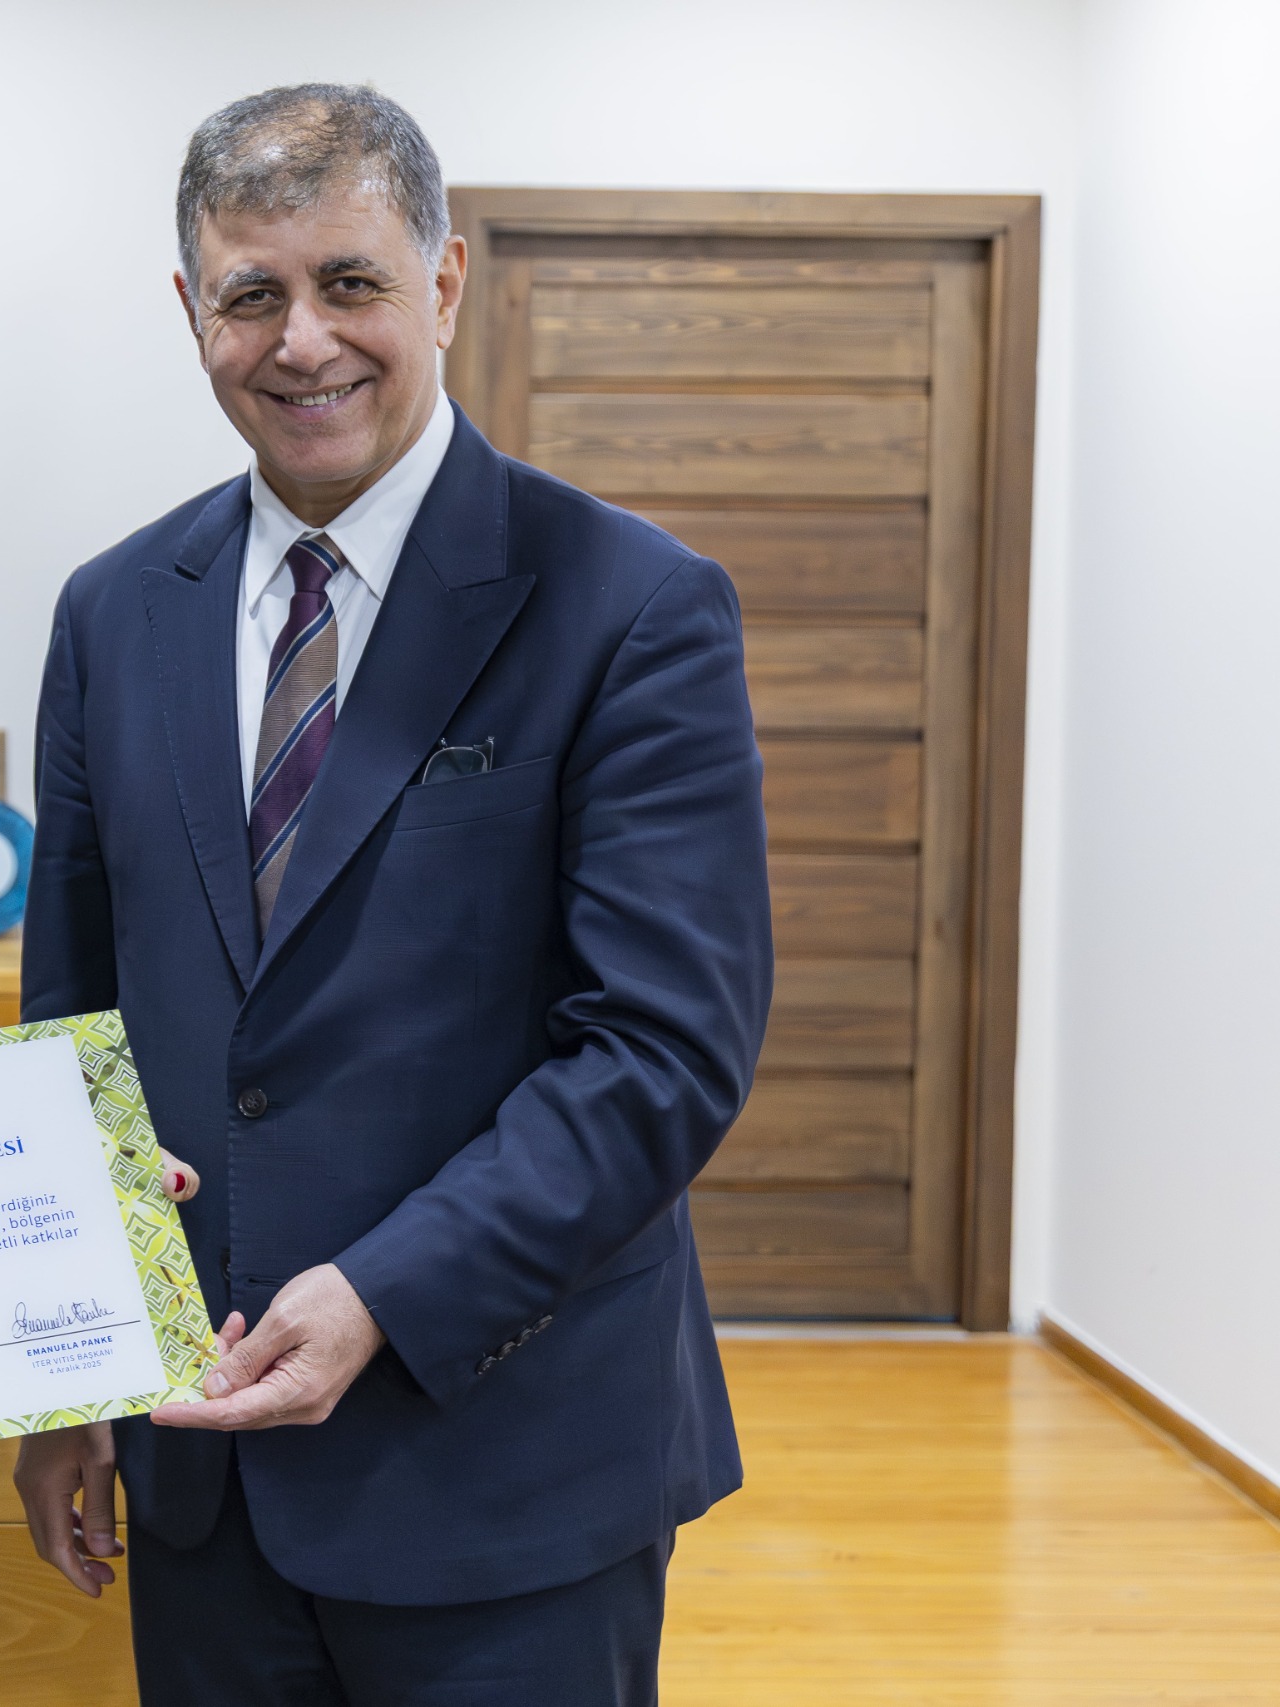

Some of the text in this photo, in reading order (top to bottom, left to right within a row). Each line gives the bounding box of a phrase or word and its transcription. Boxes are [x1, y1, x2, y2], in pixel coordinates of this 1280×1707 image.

[9, 1208, 75, 1228] bölgenin
[22, 1227, 79, 1246] katkılar
[26, 1336, 113, 1356] EMANUELA PANKE
[32, 1349, 114, 1368] ITER VITIS BAŞKANI
[57, 1364, 80, 1373] Aralık
[82, 1360, 102, 1369] 2025
